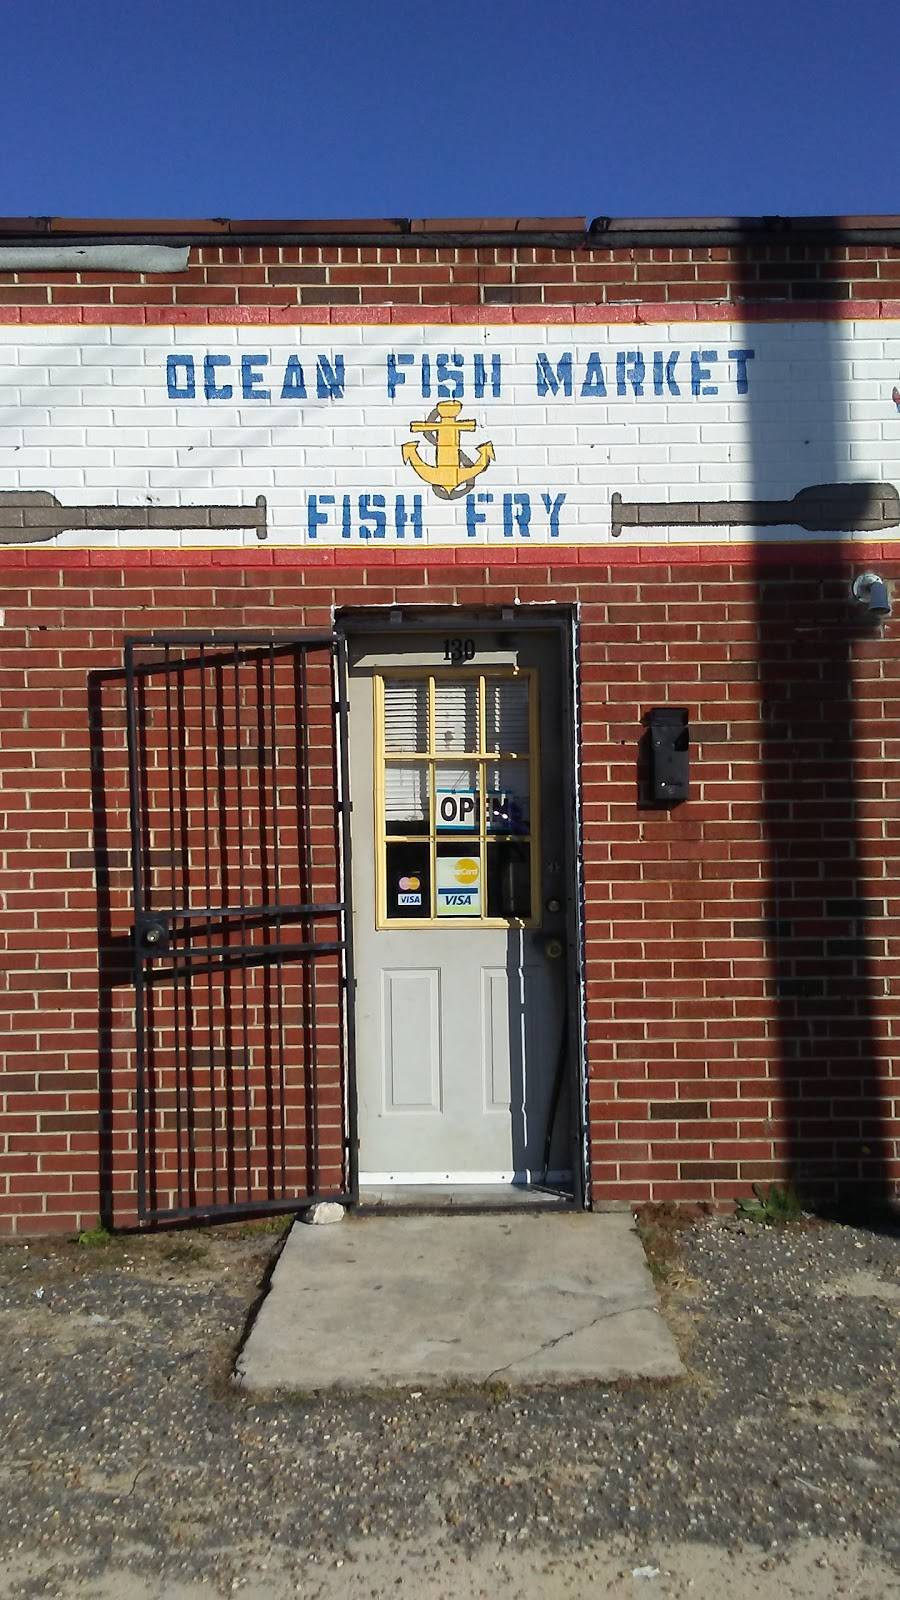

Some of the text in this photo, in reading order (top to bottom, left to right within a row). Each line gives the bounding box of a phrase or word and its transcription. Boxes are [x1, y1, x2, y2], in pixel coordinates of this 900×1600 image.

[166, 349, 755, 400] OCEAN FISH MARKET
[308, 493, 566, 539] FISH FRY
[443, 639, 475, 661] 130
[401, 895, 421, 904] VISA
[445, 895, 472, 905] VISA
